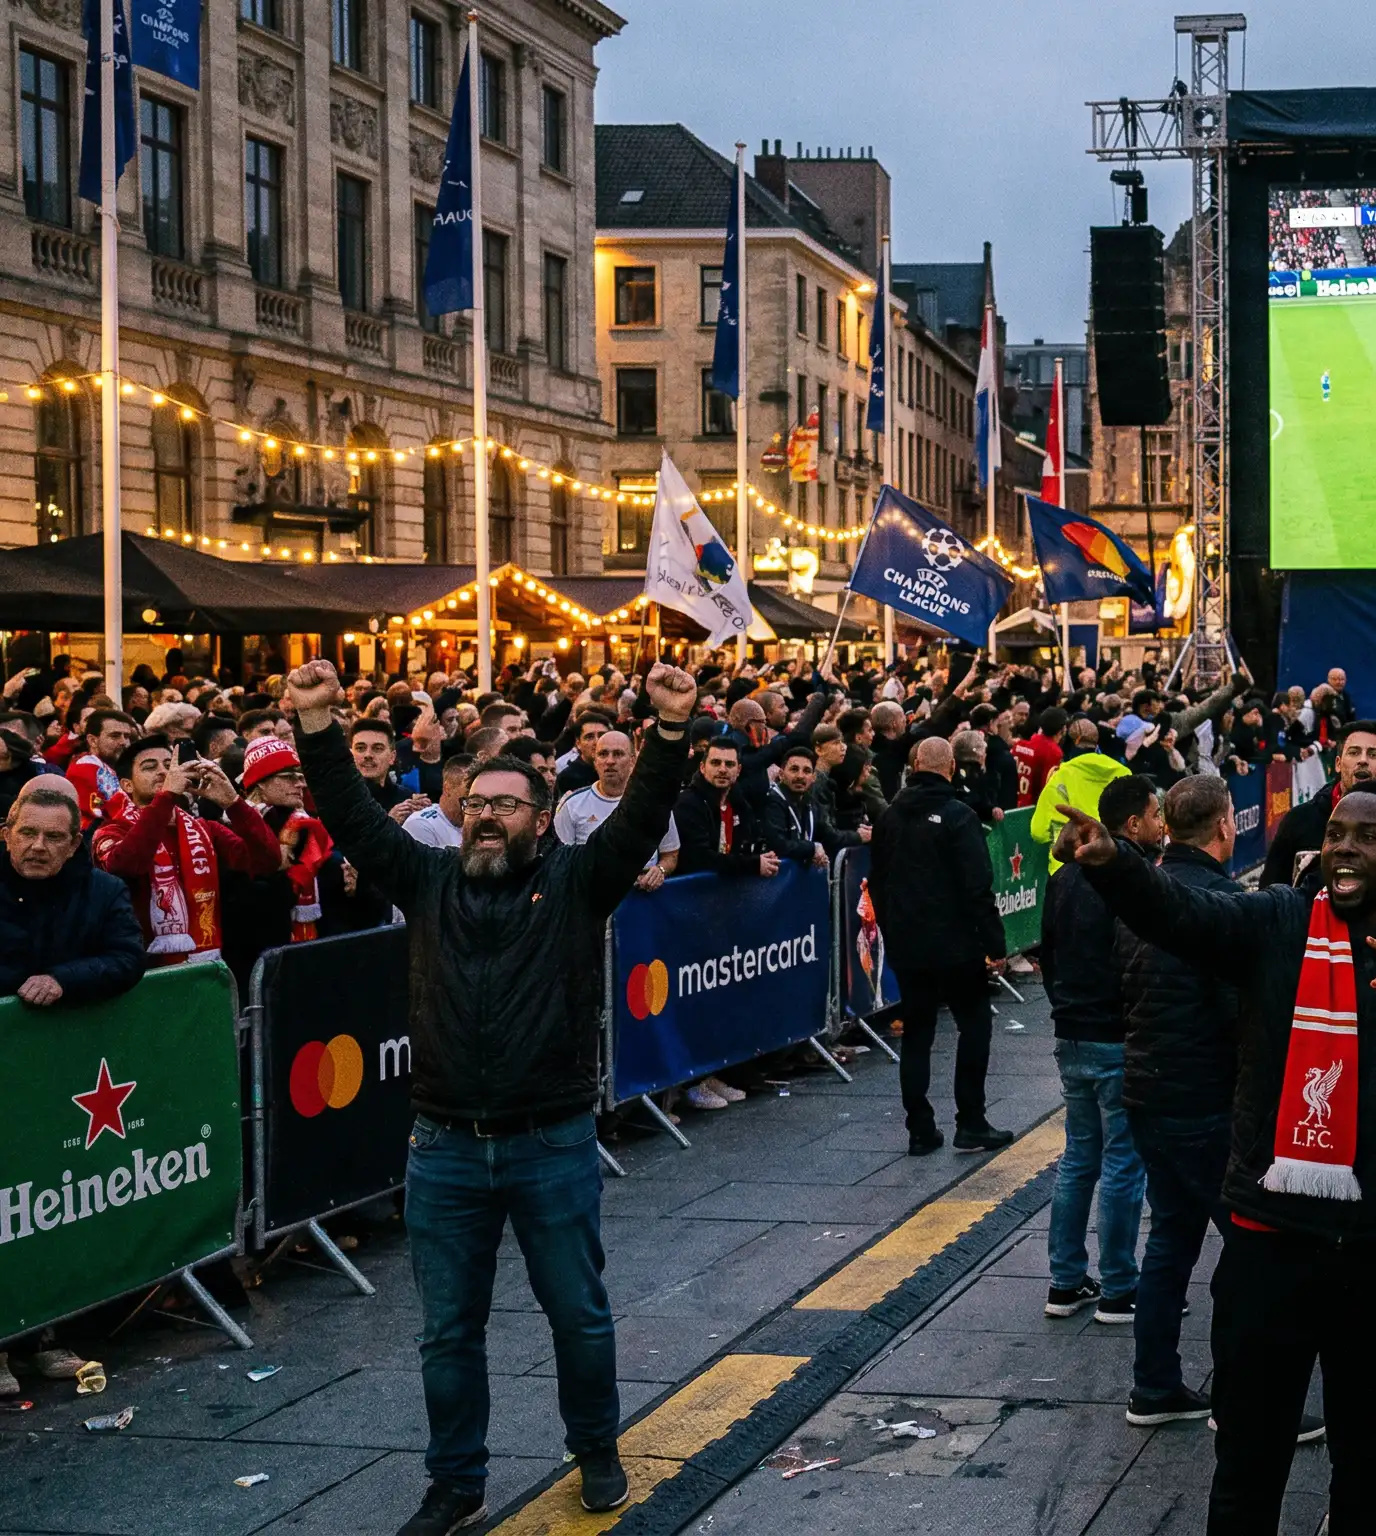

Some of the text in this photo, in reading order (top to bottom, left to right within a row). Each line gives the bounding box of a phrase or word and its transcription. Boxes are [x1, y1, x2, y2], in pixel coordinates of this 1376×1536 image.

[883, 567, 971, 614] CHAMPIONS
[678, 923, 815, 997] mastercard
[1292, 1127, 1334, 1149] L.F.C.
[0, 1141, 211, 1245] Heineken
